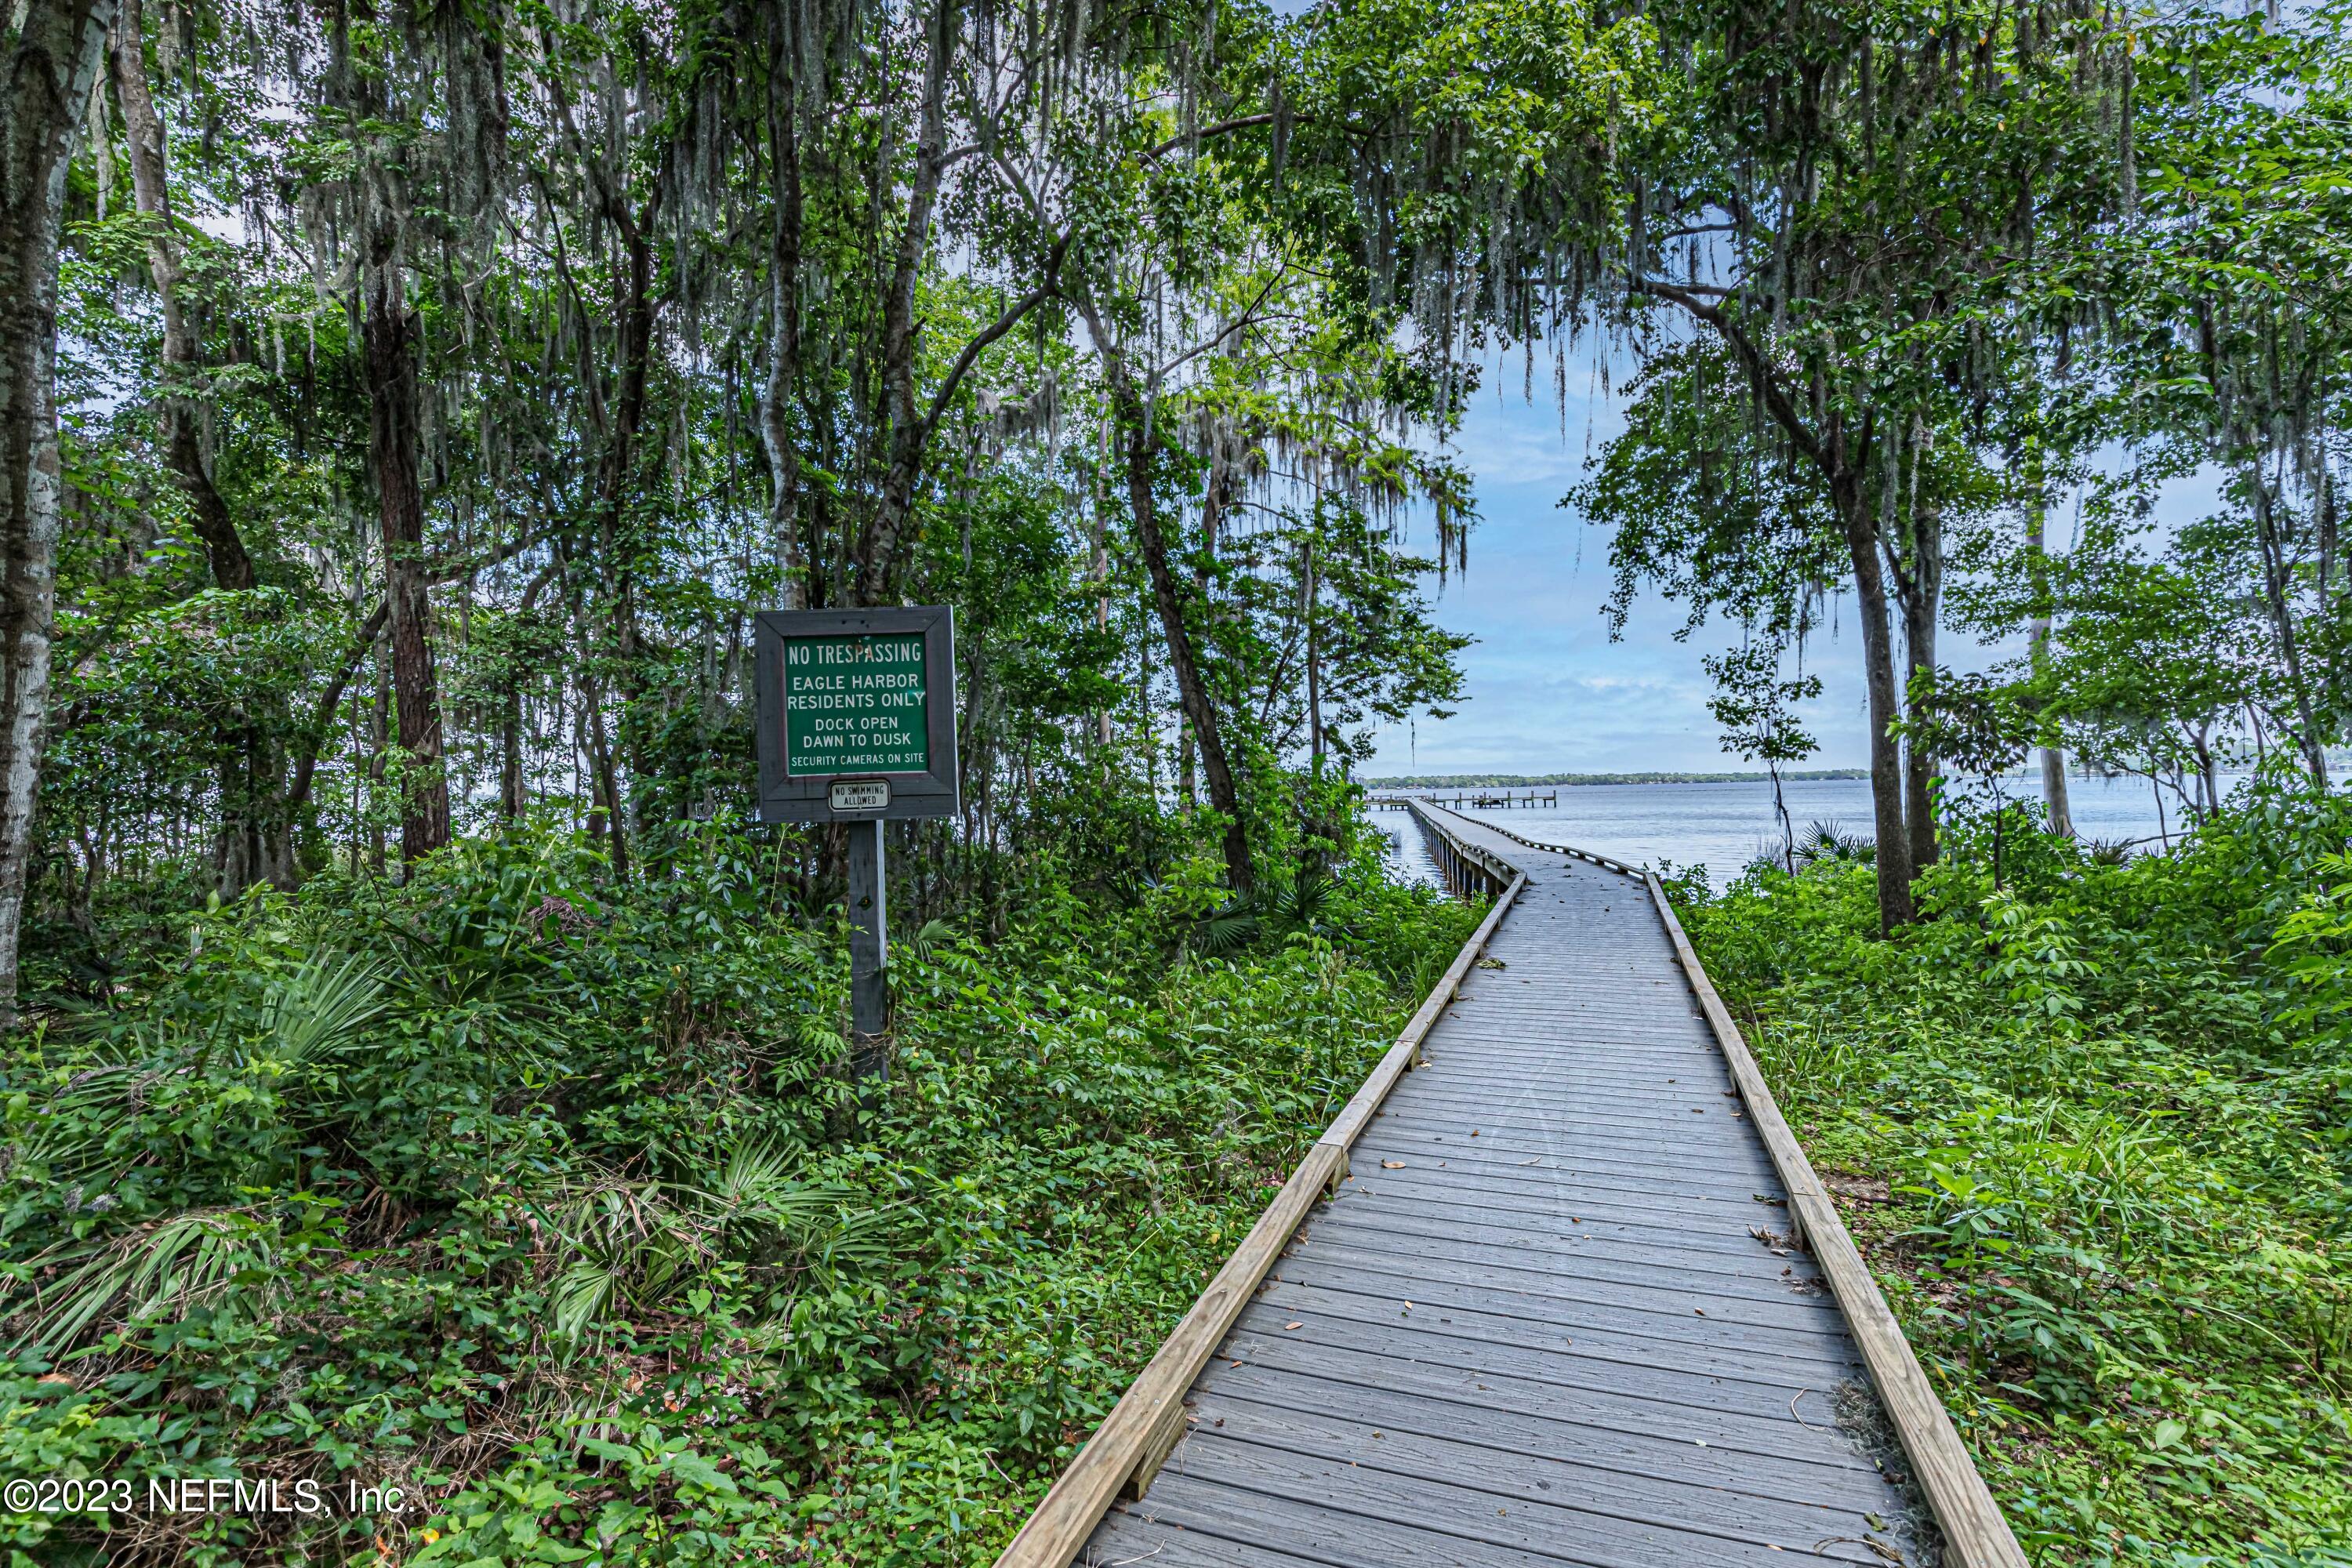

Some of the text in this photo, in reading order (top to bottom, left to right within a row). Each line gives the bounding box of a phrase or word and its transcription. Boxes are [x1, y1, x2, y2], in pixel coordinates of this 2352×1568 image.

[789, 643, 921, 665] NO TRESPASSING
[793, 674, 918, 691] EAGLE HARBOR
[788, 692, 925, 710] RESIDENTS ONLY
[815, 717, 898, 731] DOCK OPEN
[804, 733, 911, 748] DAWN TO DUSK
[792, 753, 924, 767] SECURITY CAMERAS ON SITE
[836, 786, 884, 796] NO SWIMMING
[844, 796, 877, 805] ALLOWED
